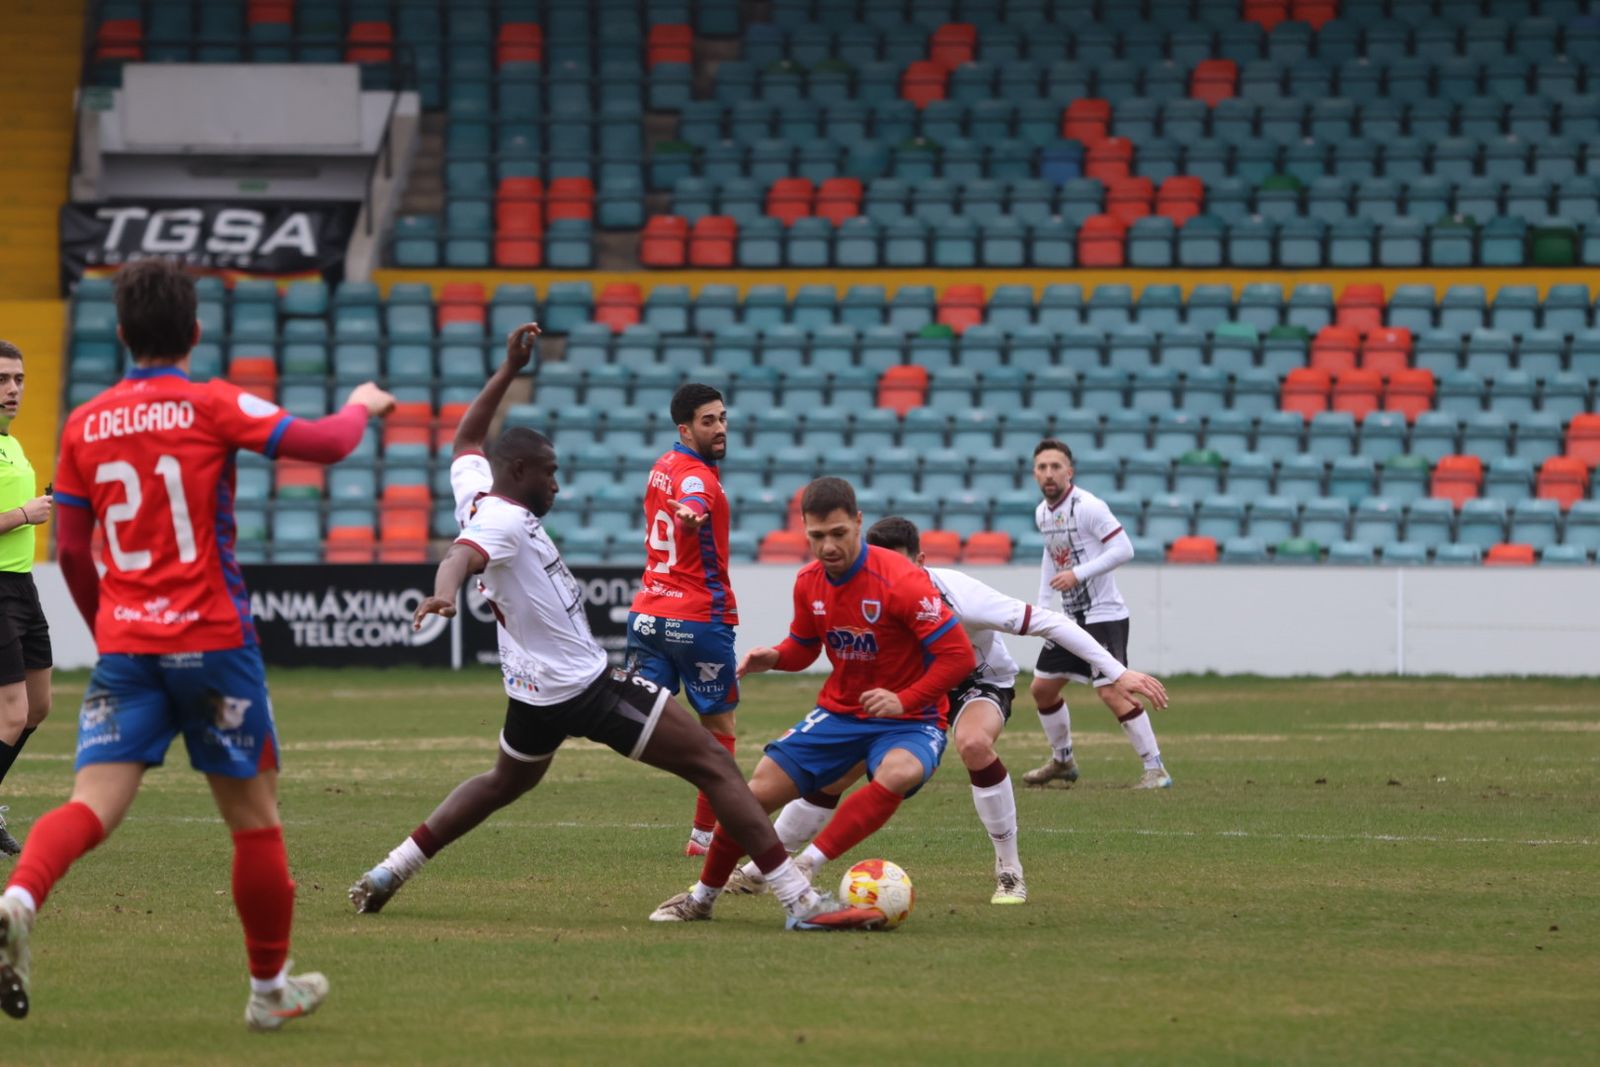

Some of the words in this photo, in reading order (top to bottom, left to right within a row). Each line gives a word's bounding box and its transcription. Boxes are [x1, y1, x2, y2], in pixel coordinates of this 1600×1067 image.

[97, 206, 316, 256] TGSA
[84, 401, 194, 443] C.DELGADO
[95, 454, 197, 573] 21
[291, 621, 412, 647] TELECOM
[631, 676, 659, 694] 3
[801, 708, 829, 733] 4
